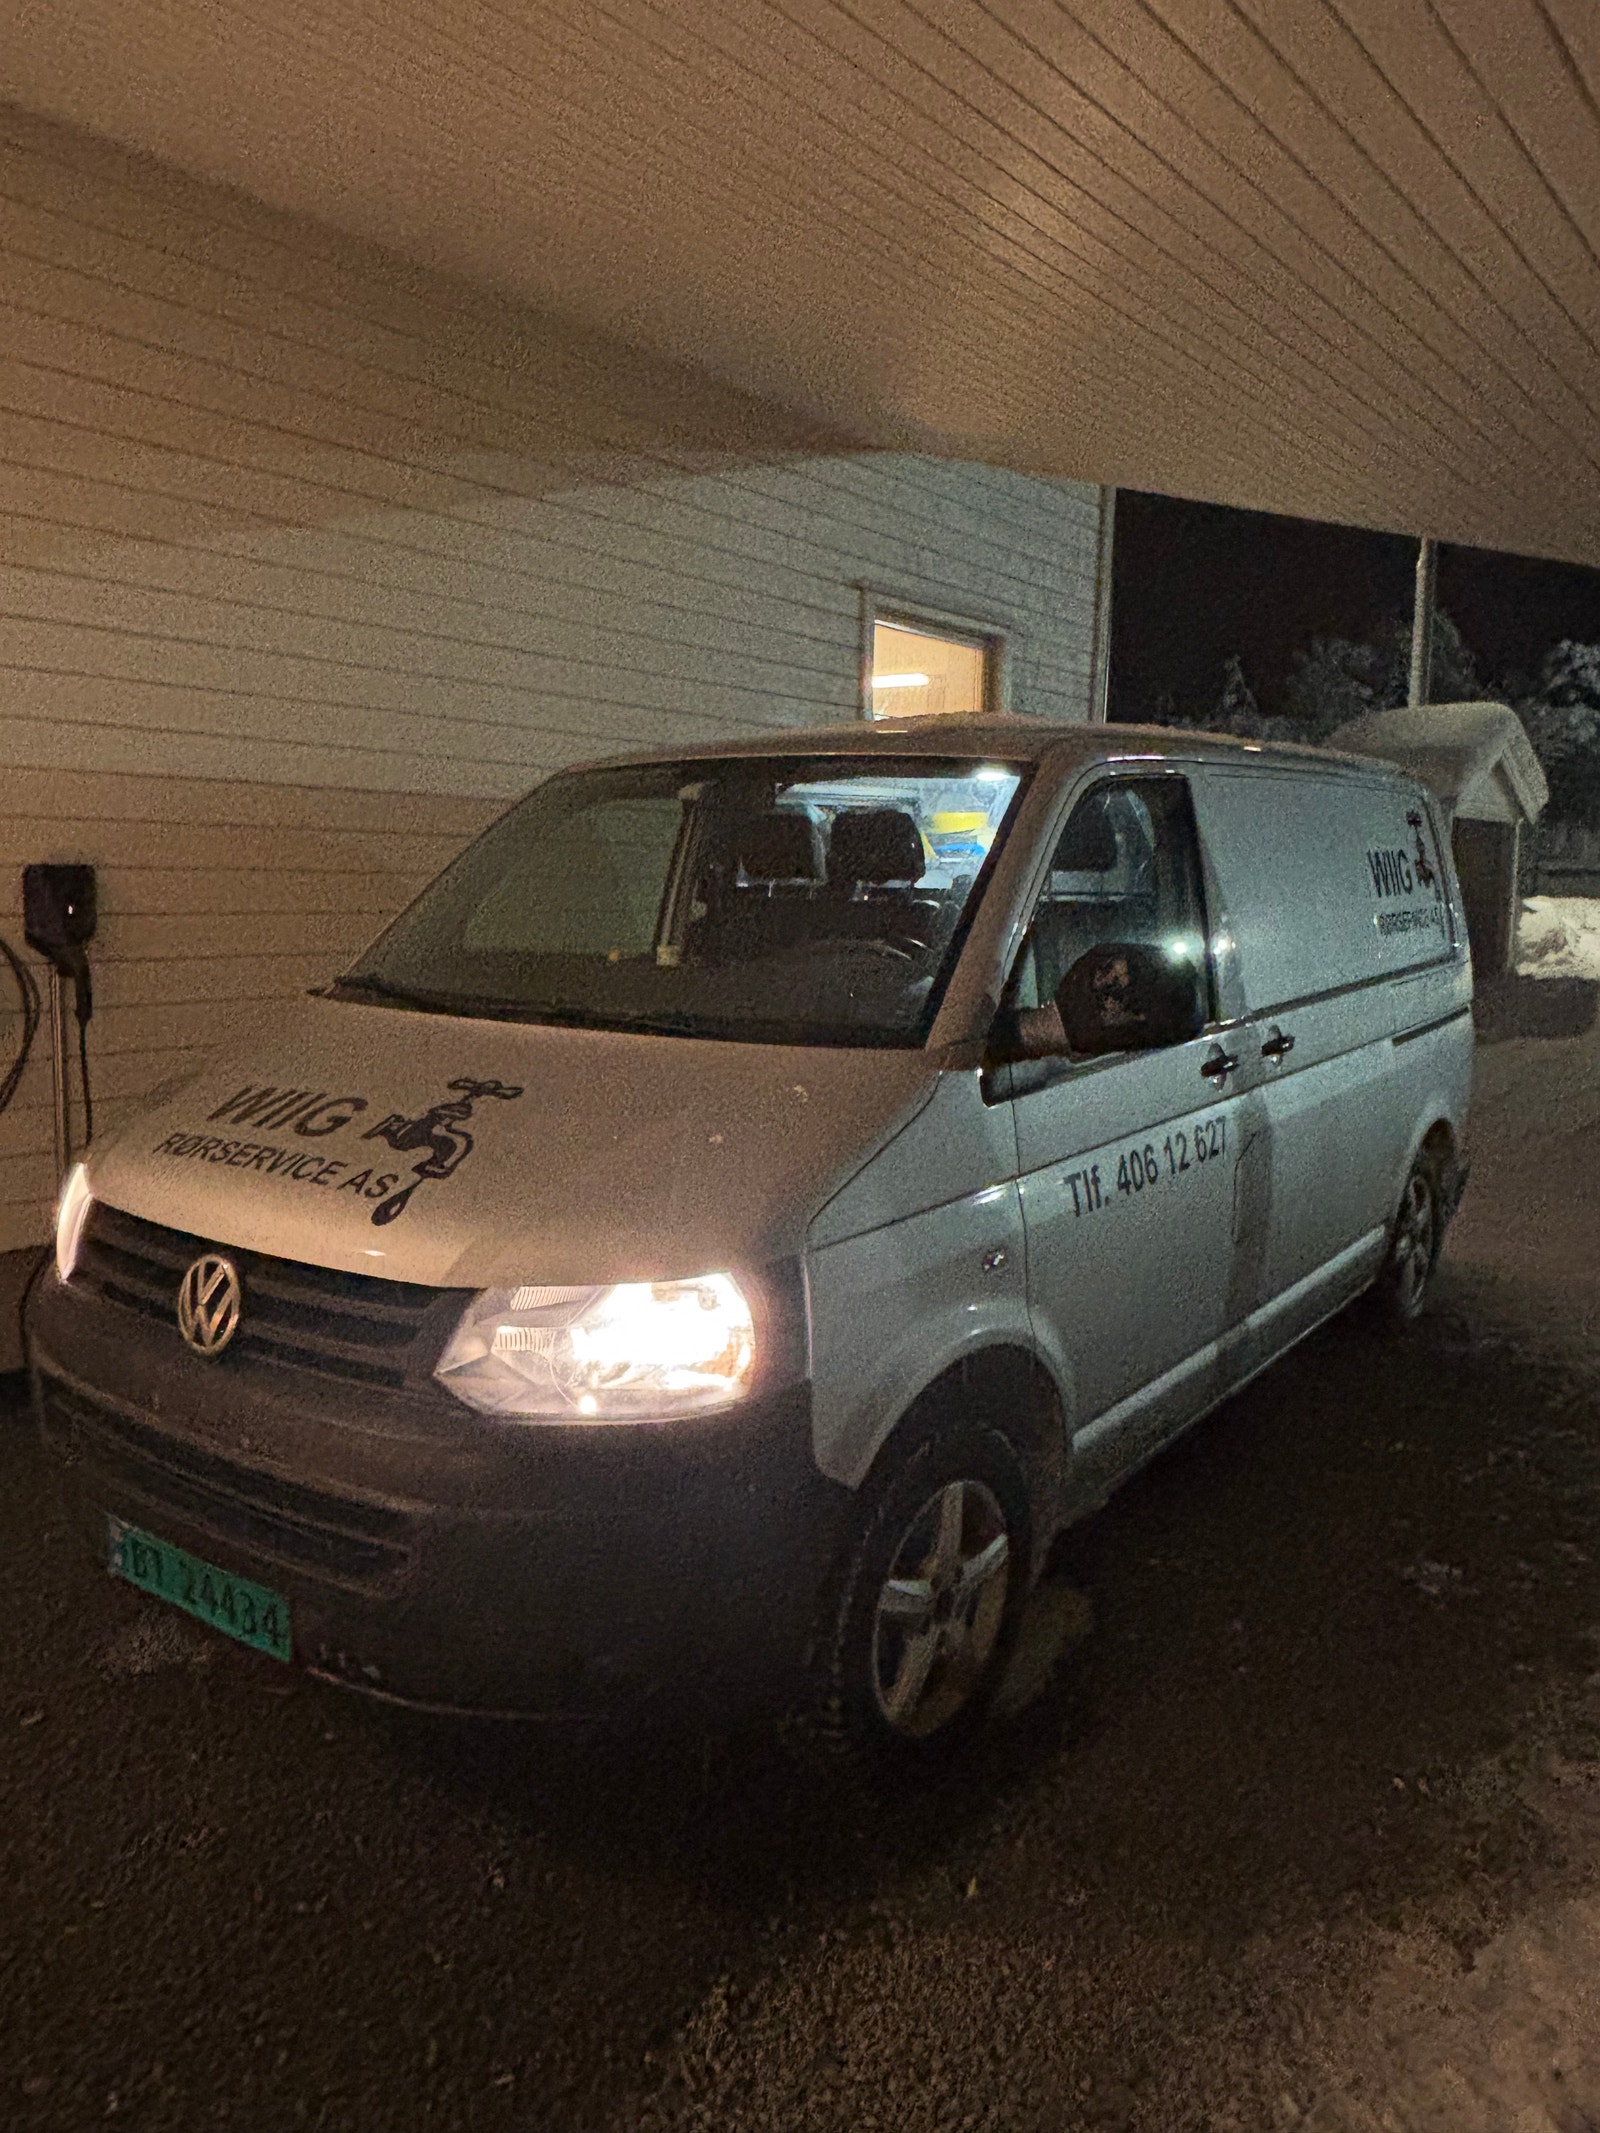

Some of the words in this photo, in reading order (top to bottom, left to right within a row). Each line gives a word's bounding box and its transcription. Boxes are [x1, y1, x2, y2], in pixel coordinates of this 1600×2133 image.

[1366, 849, 1412, 897] WIIG
[206, 1085, 368, 1137] WIIG
[152, 1132, 348, 1185] RØRSERVICE
[337, 1168, 399, 1198] AS
[1063, 1165, 1110, 1217] Tlf.
[1117, 1144, 1159, 1195] 406
[1164, 1131, 1190, 1174] 12
[1194, 1115, 1226, 1163] 627
